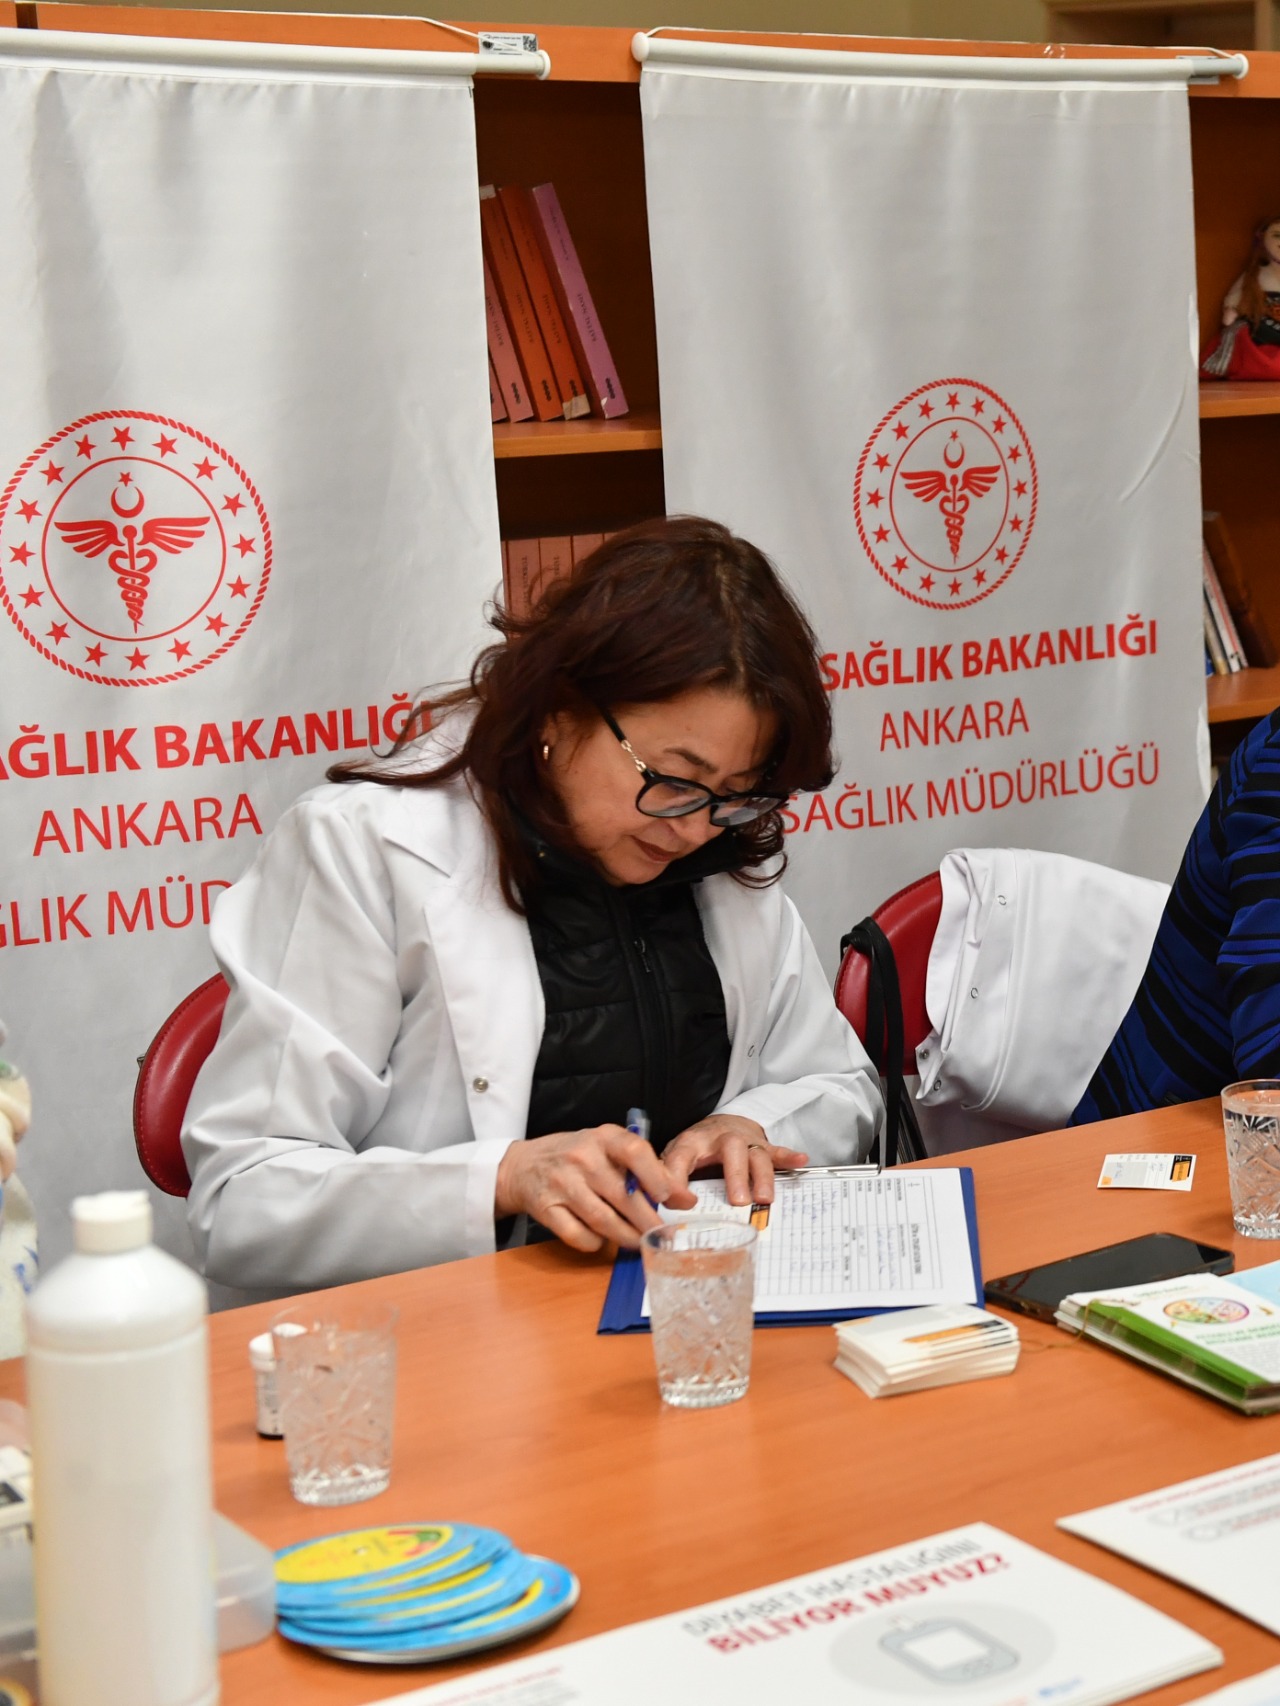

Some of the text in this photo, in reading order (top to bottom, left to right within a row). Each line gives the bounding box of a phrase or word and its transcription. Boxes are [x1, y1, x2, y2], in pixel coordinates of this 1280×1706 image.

[818, 613, 1157, 692] SAĞLIK BAKANLIĞI
[0, 693, 433, 780] ĞLIK BAKANLIĞI
[880, 698, 1030, 751] ANKARA
[779, 742, 1160, 834] SAĞLIK MÜDÜRLÜĞÜ
[32, 793, 263, 857] ANKARA
[0, 893, 92, 949] LIK
